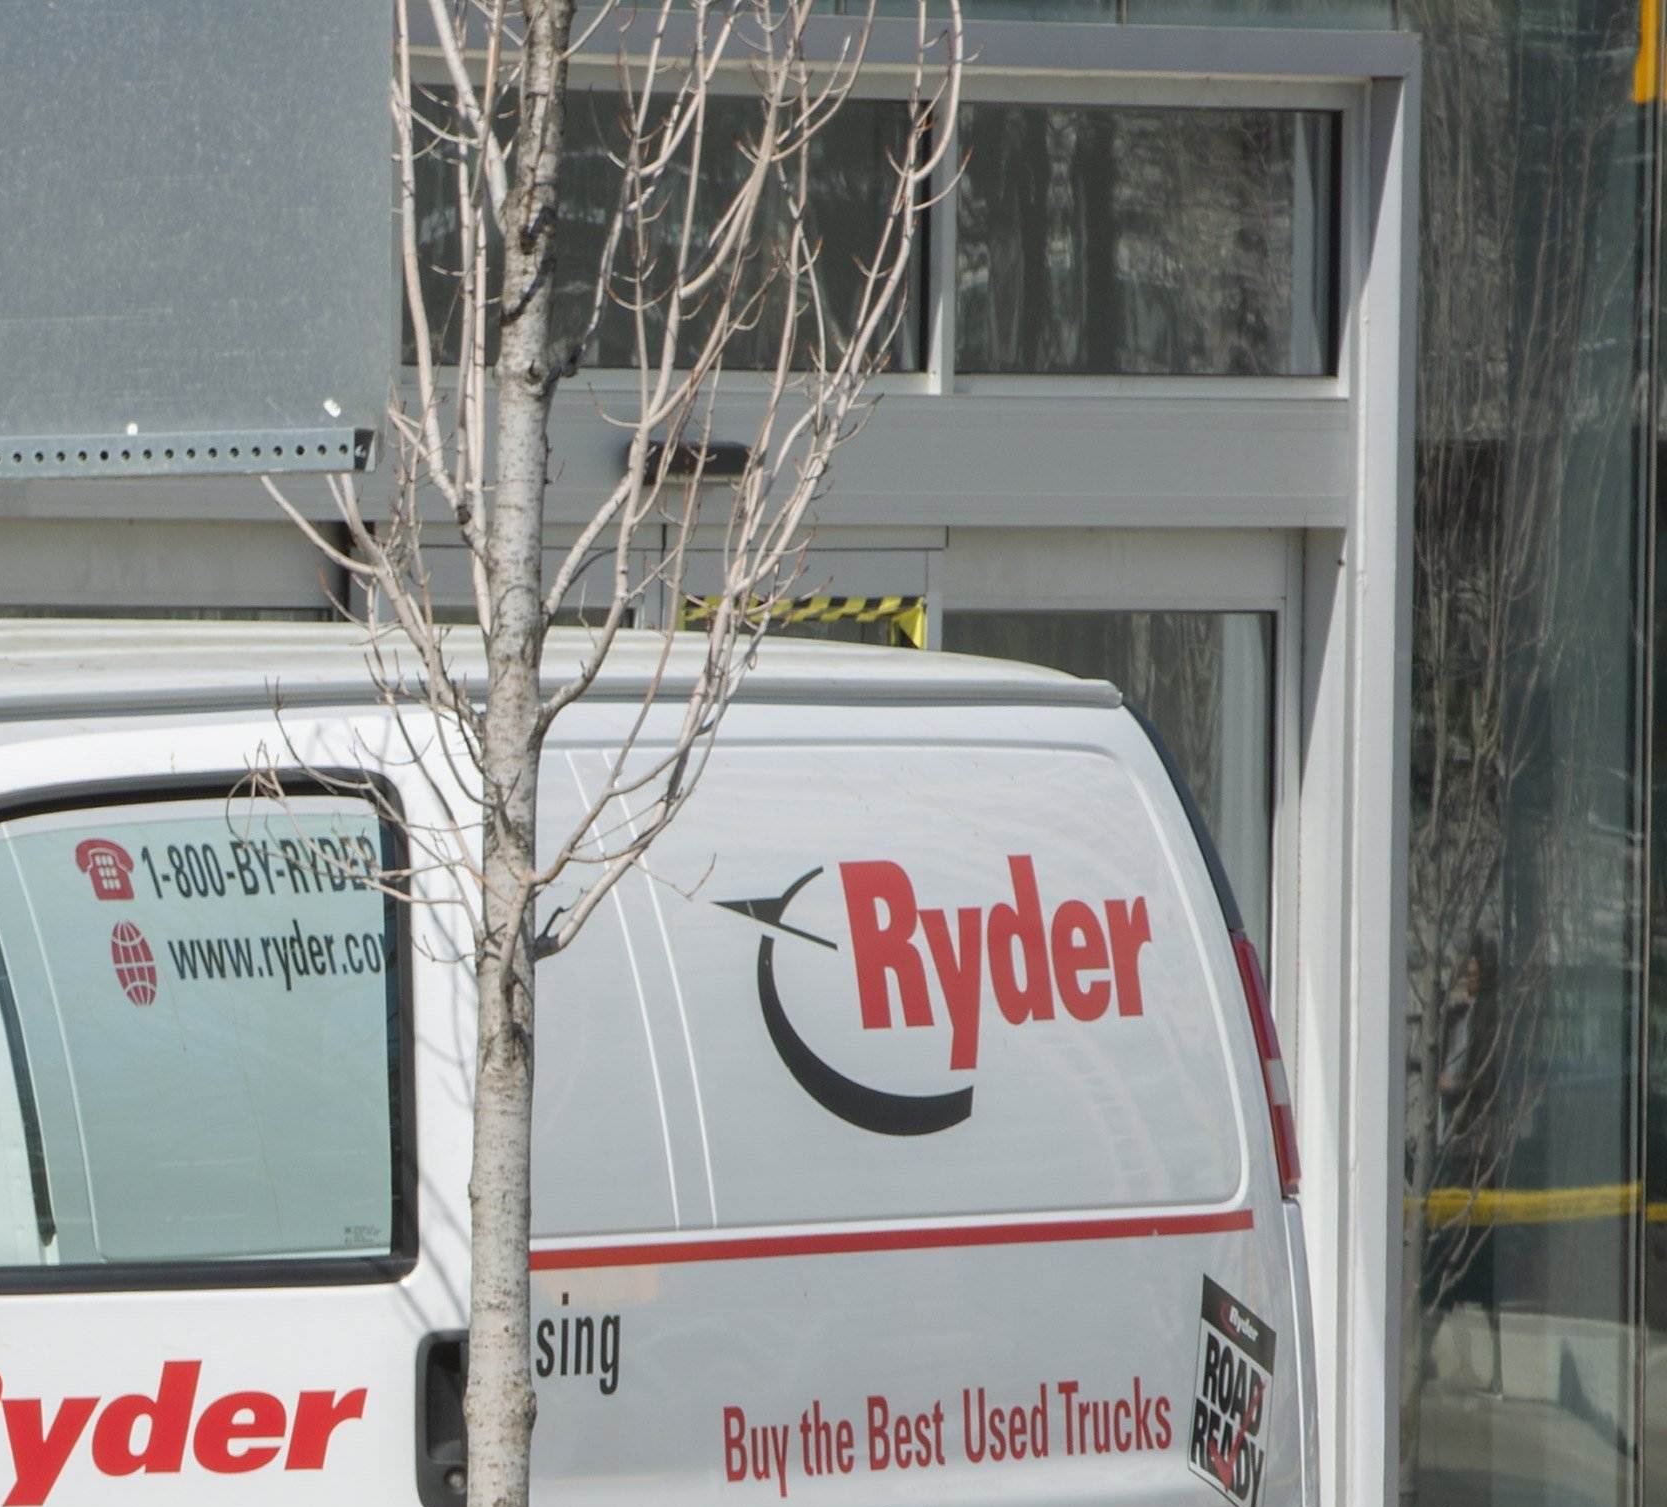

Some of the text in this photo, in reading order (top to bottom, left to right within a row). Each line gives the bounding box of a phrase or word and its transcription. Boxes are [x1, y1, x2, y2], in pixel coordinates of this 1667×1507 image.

[838, 854, 1151, 1070] Ryder
[536, 1291, 621, 1397] sing
[1203, 1330, 1267, 1437] ROAD
[723, 1376, 1173, 1498] Buy the Best Used Trucks
